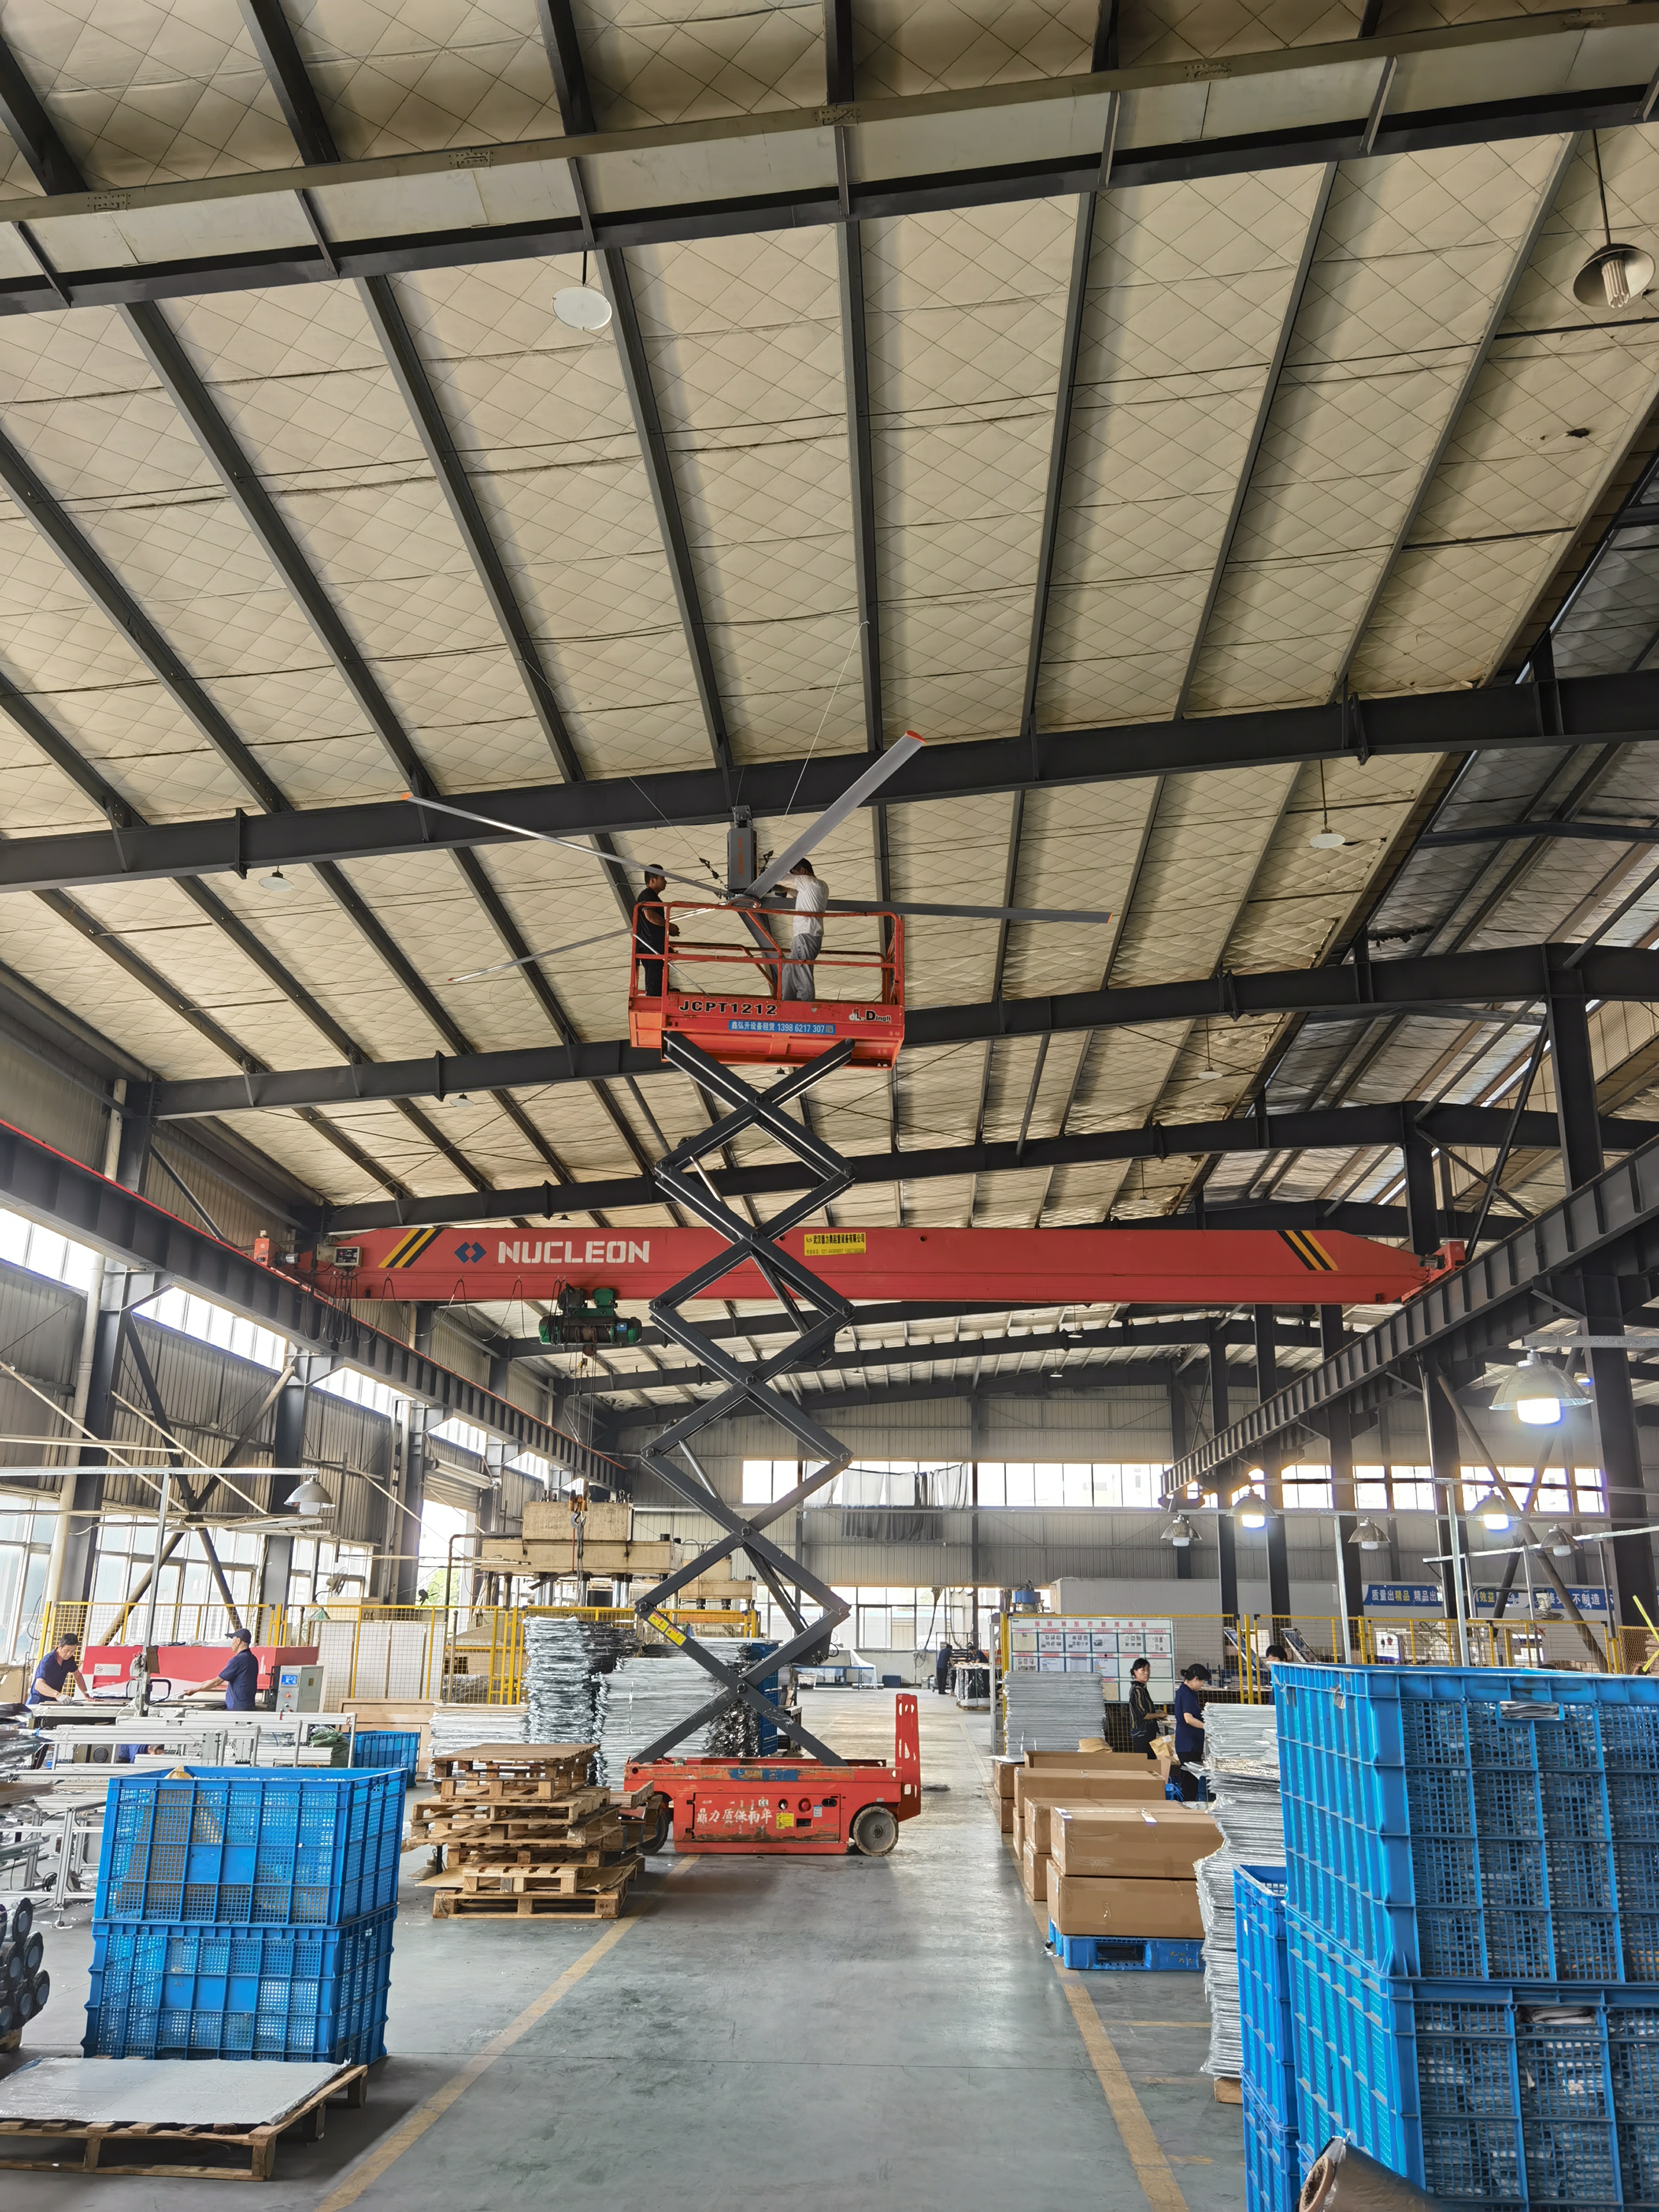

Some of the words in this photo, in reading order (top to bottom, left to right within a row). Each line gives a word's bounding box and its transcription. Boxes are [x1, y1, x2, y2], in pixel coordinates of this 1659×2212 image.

[679, 1000, 777, 1015] JCPT1212
[865, 1009, 891, 1023] Dingli
[731, 1021, 775, 1031] 鑫弘升设备租赁
[777, 1023, 793, 1031] 1398
[795, 1024, 810, 1033] 6217
[813, 1025, 825, 1033] 307
[498, 1241, 650, 1264] NUCLEON
[1371, 1589, 1410, 1602] 质量出精品
[1572, 1593, 1601, 1605] 不制造
[697, 1808, 772, 1825] 鼎力质保两年
